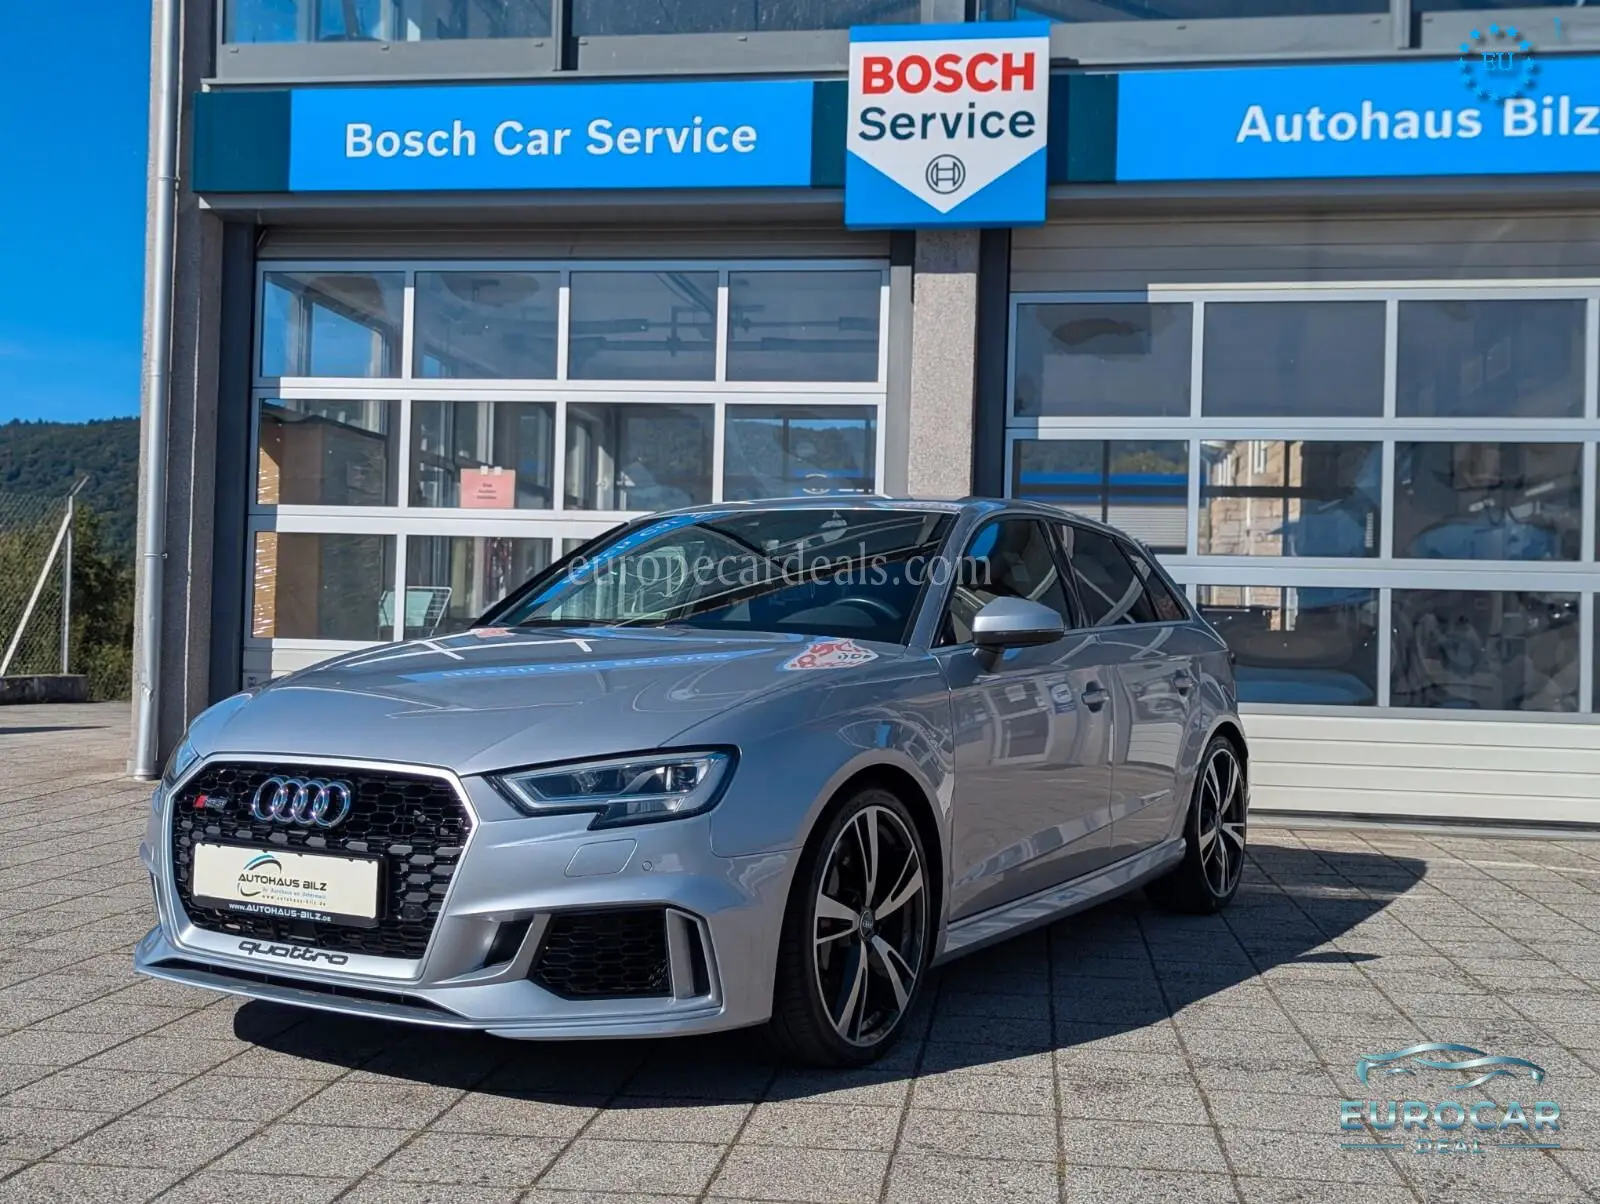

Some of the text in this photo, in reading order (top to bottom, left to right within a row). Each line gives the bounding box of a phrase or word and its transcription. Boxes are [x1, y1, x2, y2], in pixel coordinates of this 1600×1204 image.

[862, 52, 1035, 94] BOSCH
[345, 116, 758, 157] Bosch Car Service
[858, 102, 1036, 141] Service
[1236, 95, 1600, 143] Autohaus Bilz
[238, 873, 328, 891] AUTOHAUS BILZ
[238, 940, 349, 966] quattro
